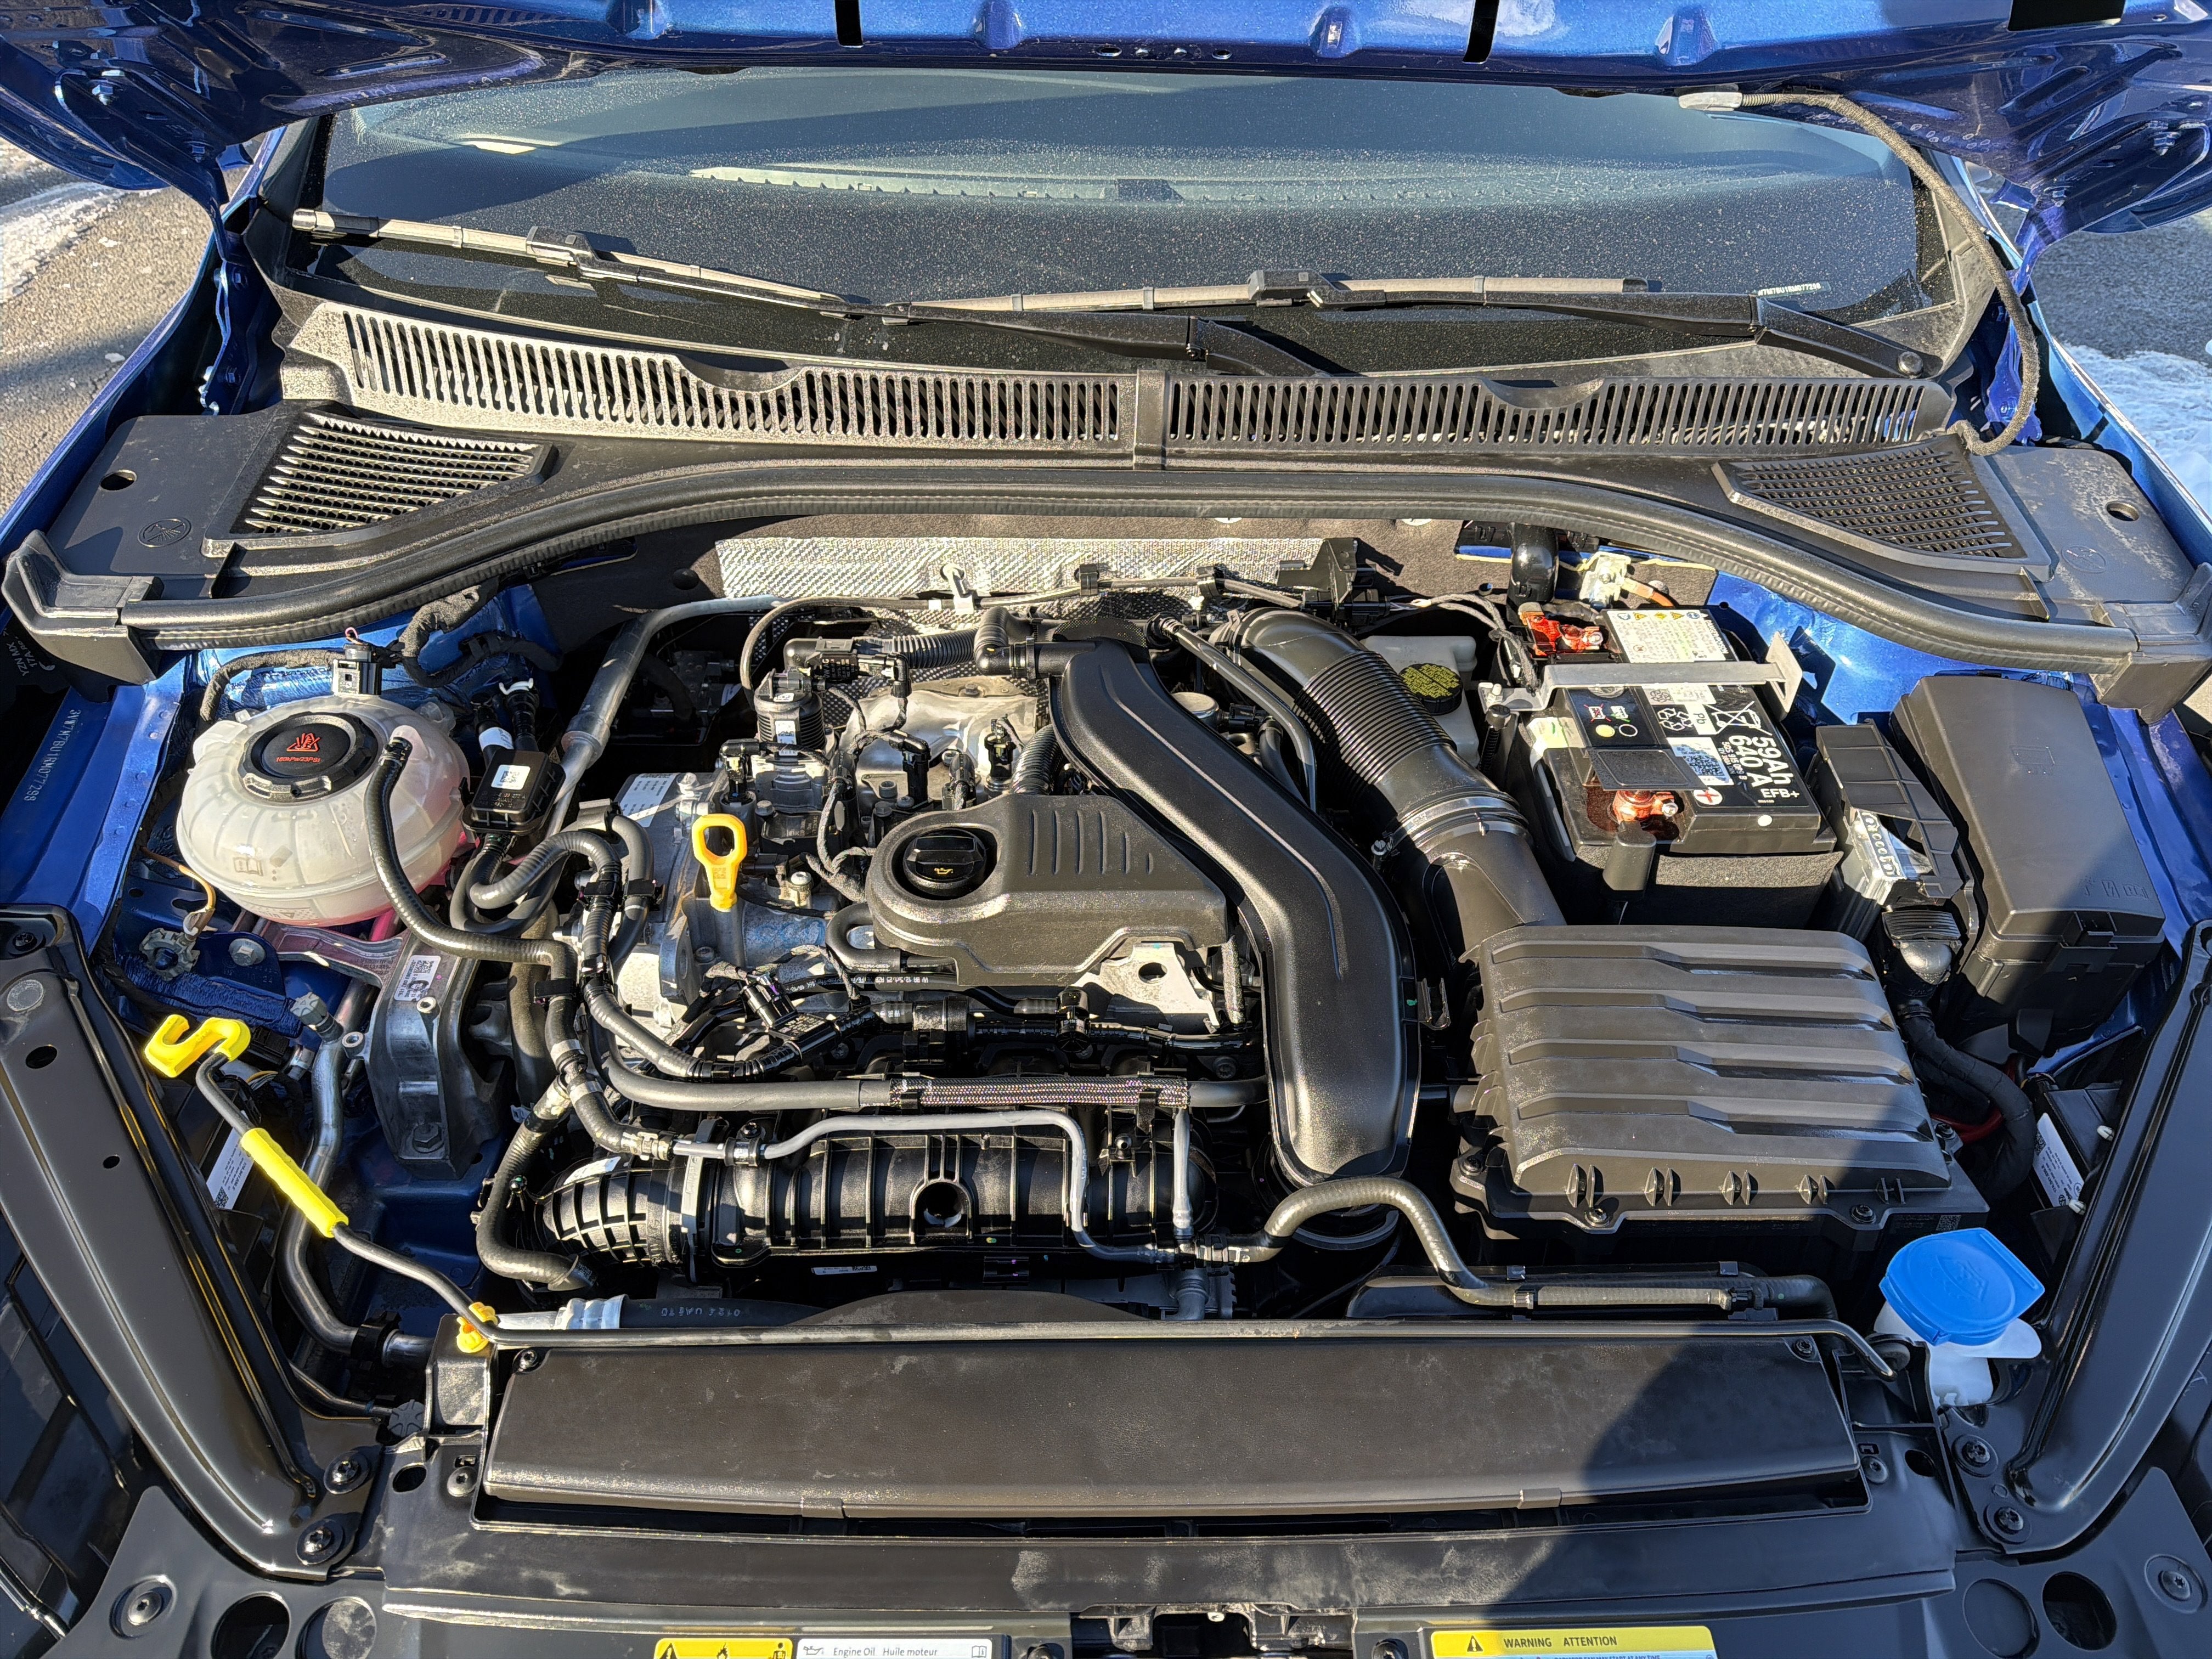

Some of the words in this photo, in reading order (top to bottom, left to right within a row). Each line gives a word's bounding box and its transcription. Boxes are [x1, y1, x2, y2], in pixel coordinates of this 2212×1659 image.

[7, 642, 21, 657] MX
[1693, 713, 1706, 725] Pb
[1728, 735, 1764, 768] 640
[1746, 772, 1773, 787] A
[1752, 736, 1794, 785] 59Ah
[1760, 788, 1800, 798] EFB+
[1504, 1638, 1552, 1648] WARNING
[1564, 1636, 1618, 1646] ATTENTION
[833, 1647, 861, 1658] Engine
[864, 1647, 876, 1656] Oil
[883, 1647, 904, 1656] Huile
